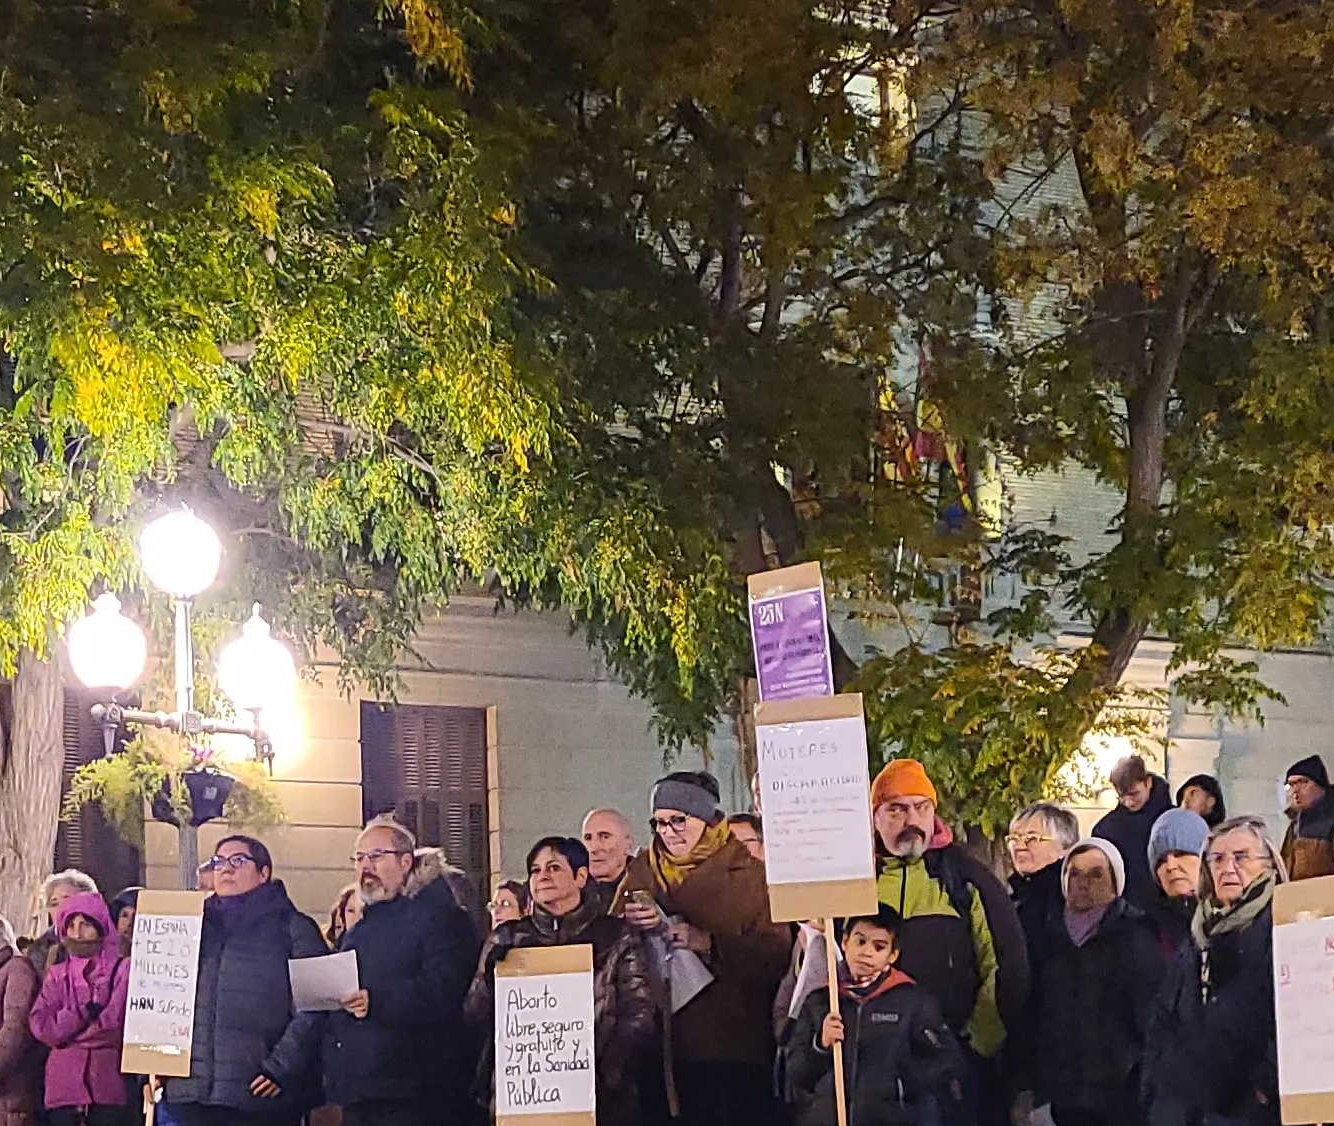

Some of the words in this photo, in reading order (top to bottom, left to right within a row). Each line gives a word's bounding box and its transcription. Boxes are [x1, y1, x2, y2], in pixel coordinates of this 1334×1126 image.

[758, 602, 784, 626] 25N
[147, 940, 162, 954] DE
[134, 958, 189, 979] MILLONES
[130, 997, 154, 1011] HAN
[507, 984, 557, 1011] Aborto
[516, 1030, 565, 1064] gratuito
[505, 1065, 521, 1076] en
[527, 1052, 541, 1074] la
[545, 1050, 589, 1073] Sanidad
